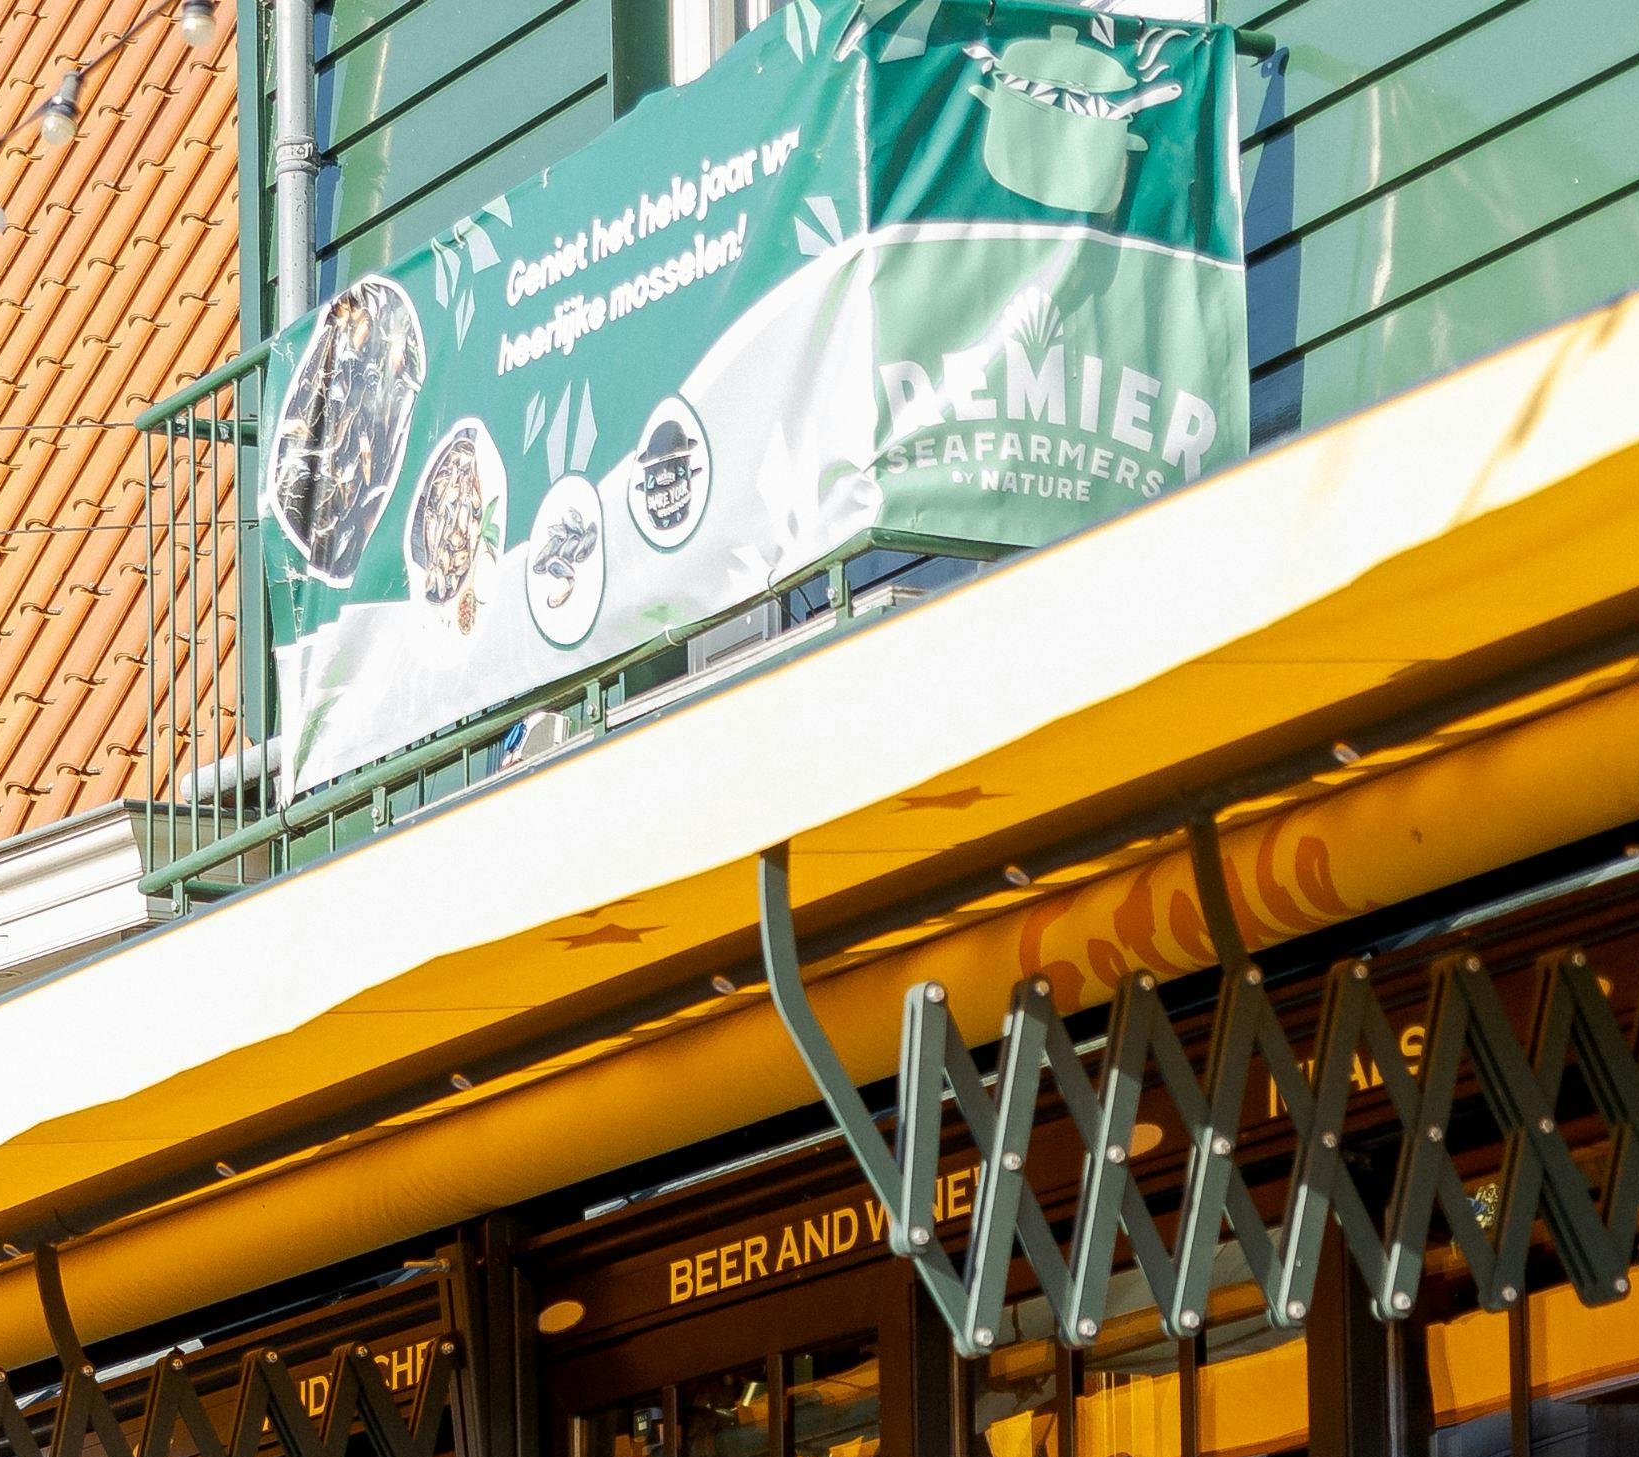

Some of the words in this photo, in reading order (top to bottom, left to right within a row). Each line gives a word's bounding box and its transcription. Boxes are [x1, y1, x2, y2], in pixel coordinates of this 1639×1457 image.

[506, 232, 588, 306] Geniet
[592, 207, 635, 263] het
[638, 176, 697, 239] hele
[696, 159, 758, 222] jaar
[497, 294, 607, 377] heerlijke
[608, 213, 748, 322] mosselen!
[884, 431, 1166, 499] SEAFARMERS
[980, 469, 1092, 502] NATURE
[669, 1235, 769, 1305] BEER
[776, 1207, 859, 1272] AND
